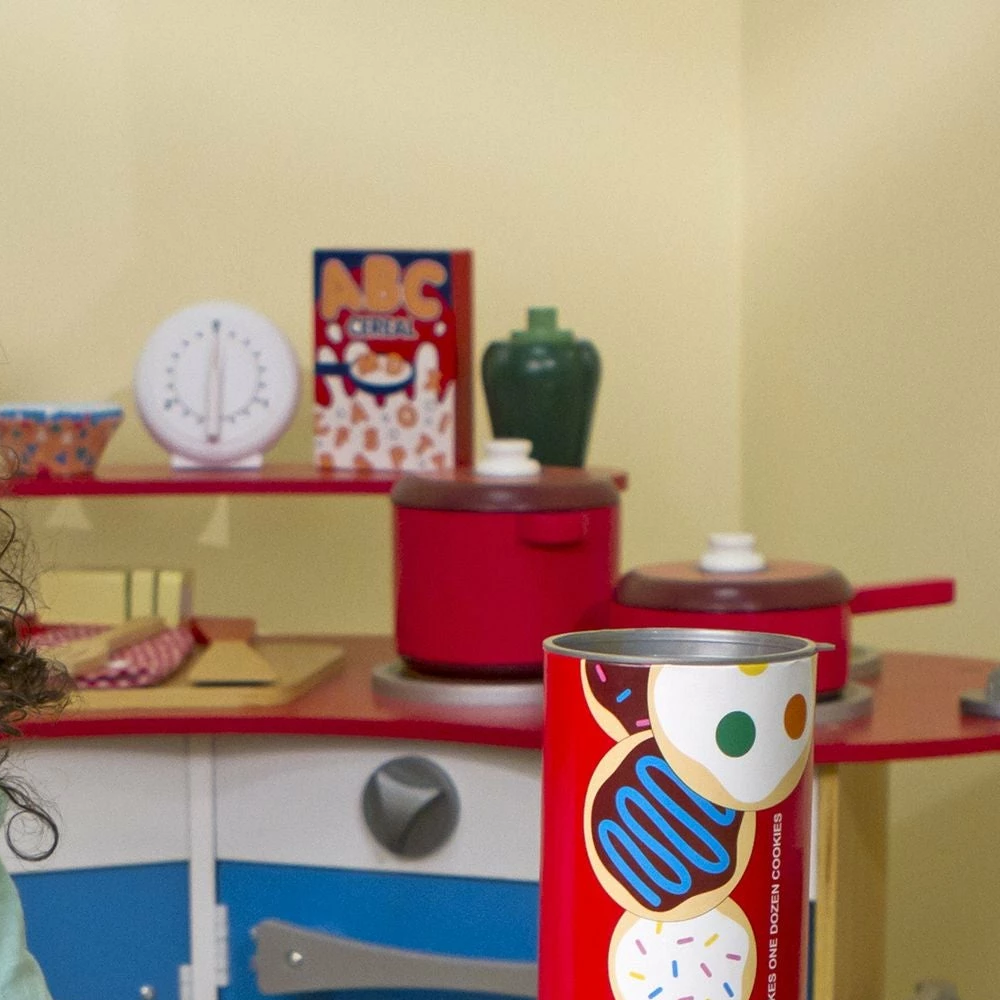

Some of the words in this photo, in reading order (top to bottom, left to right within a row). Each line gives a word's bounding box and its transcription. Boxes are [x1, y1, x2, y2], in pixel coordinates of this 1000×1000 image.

[319, 253, 448, 322] ABC
[771, 812, 783, 881] COOKIES
[769, 883, 780, 933] DOZEN
[768, 937, 778, 970] ONE
